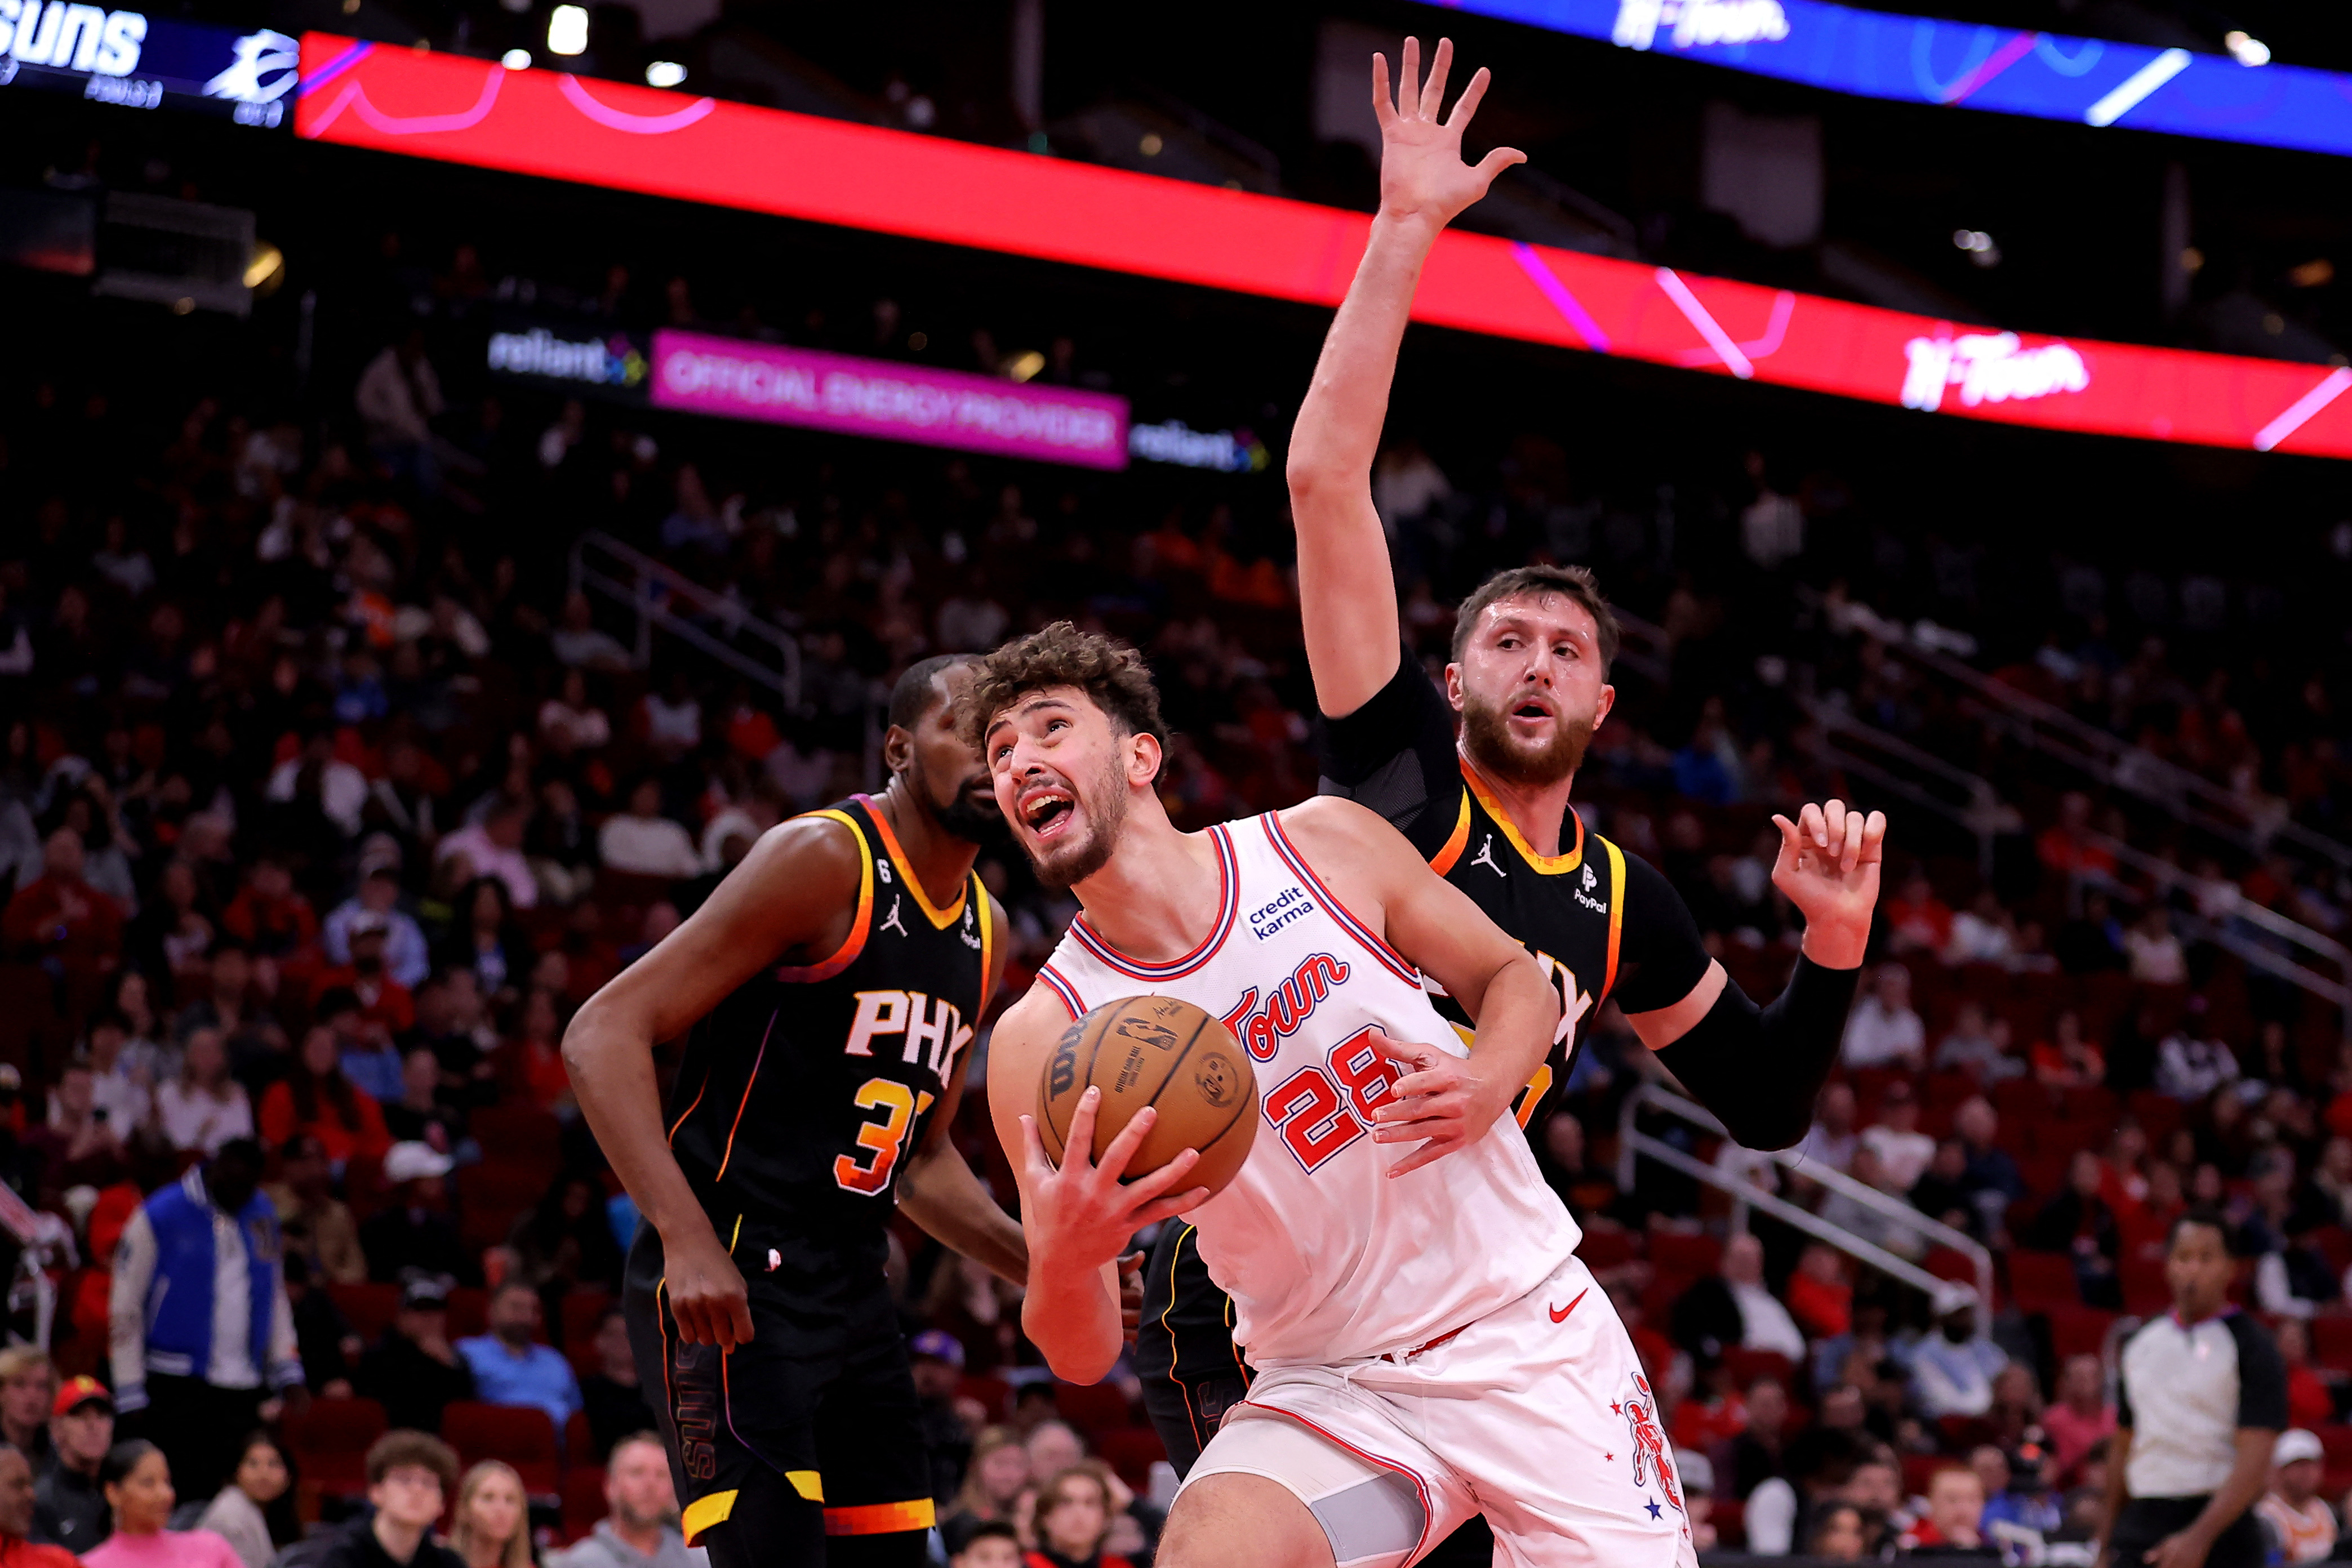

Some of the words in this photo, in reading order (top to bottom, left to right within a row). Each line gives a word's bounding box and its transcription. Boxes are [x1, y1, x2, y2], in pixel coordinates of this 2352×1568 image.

[664, 350, 821, 412] OFFICIAL
[825, 371, 951, 426] ENERGY
[877, 858, 891, 884] 6
[1249, 887, 1303, 924] credit
[1253, 901, 1314, 941] karma
[1574, 888, 1607, 914] PayPal
[1261, 1023, 1405, 1175] 28
[834, 1077, 934, 1205] 3
